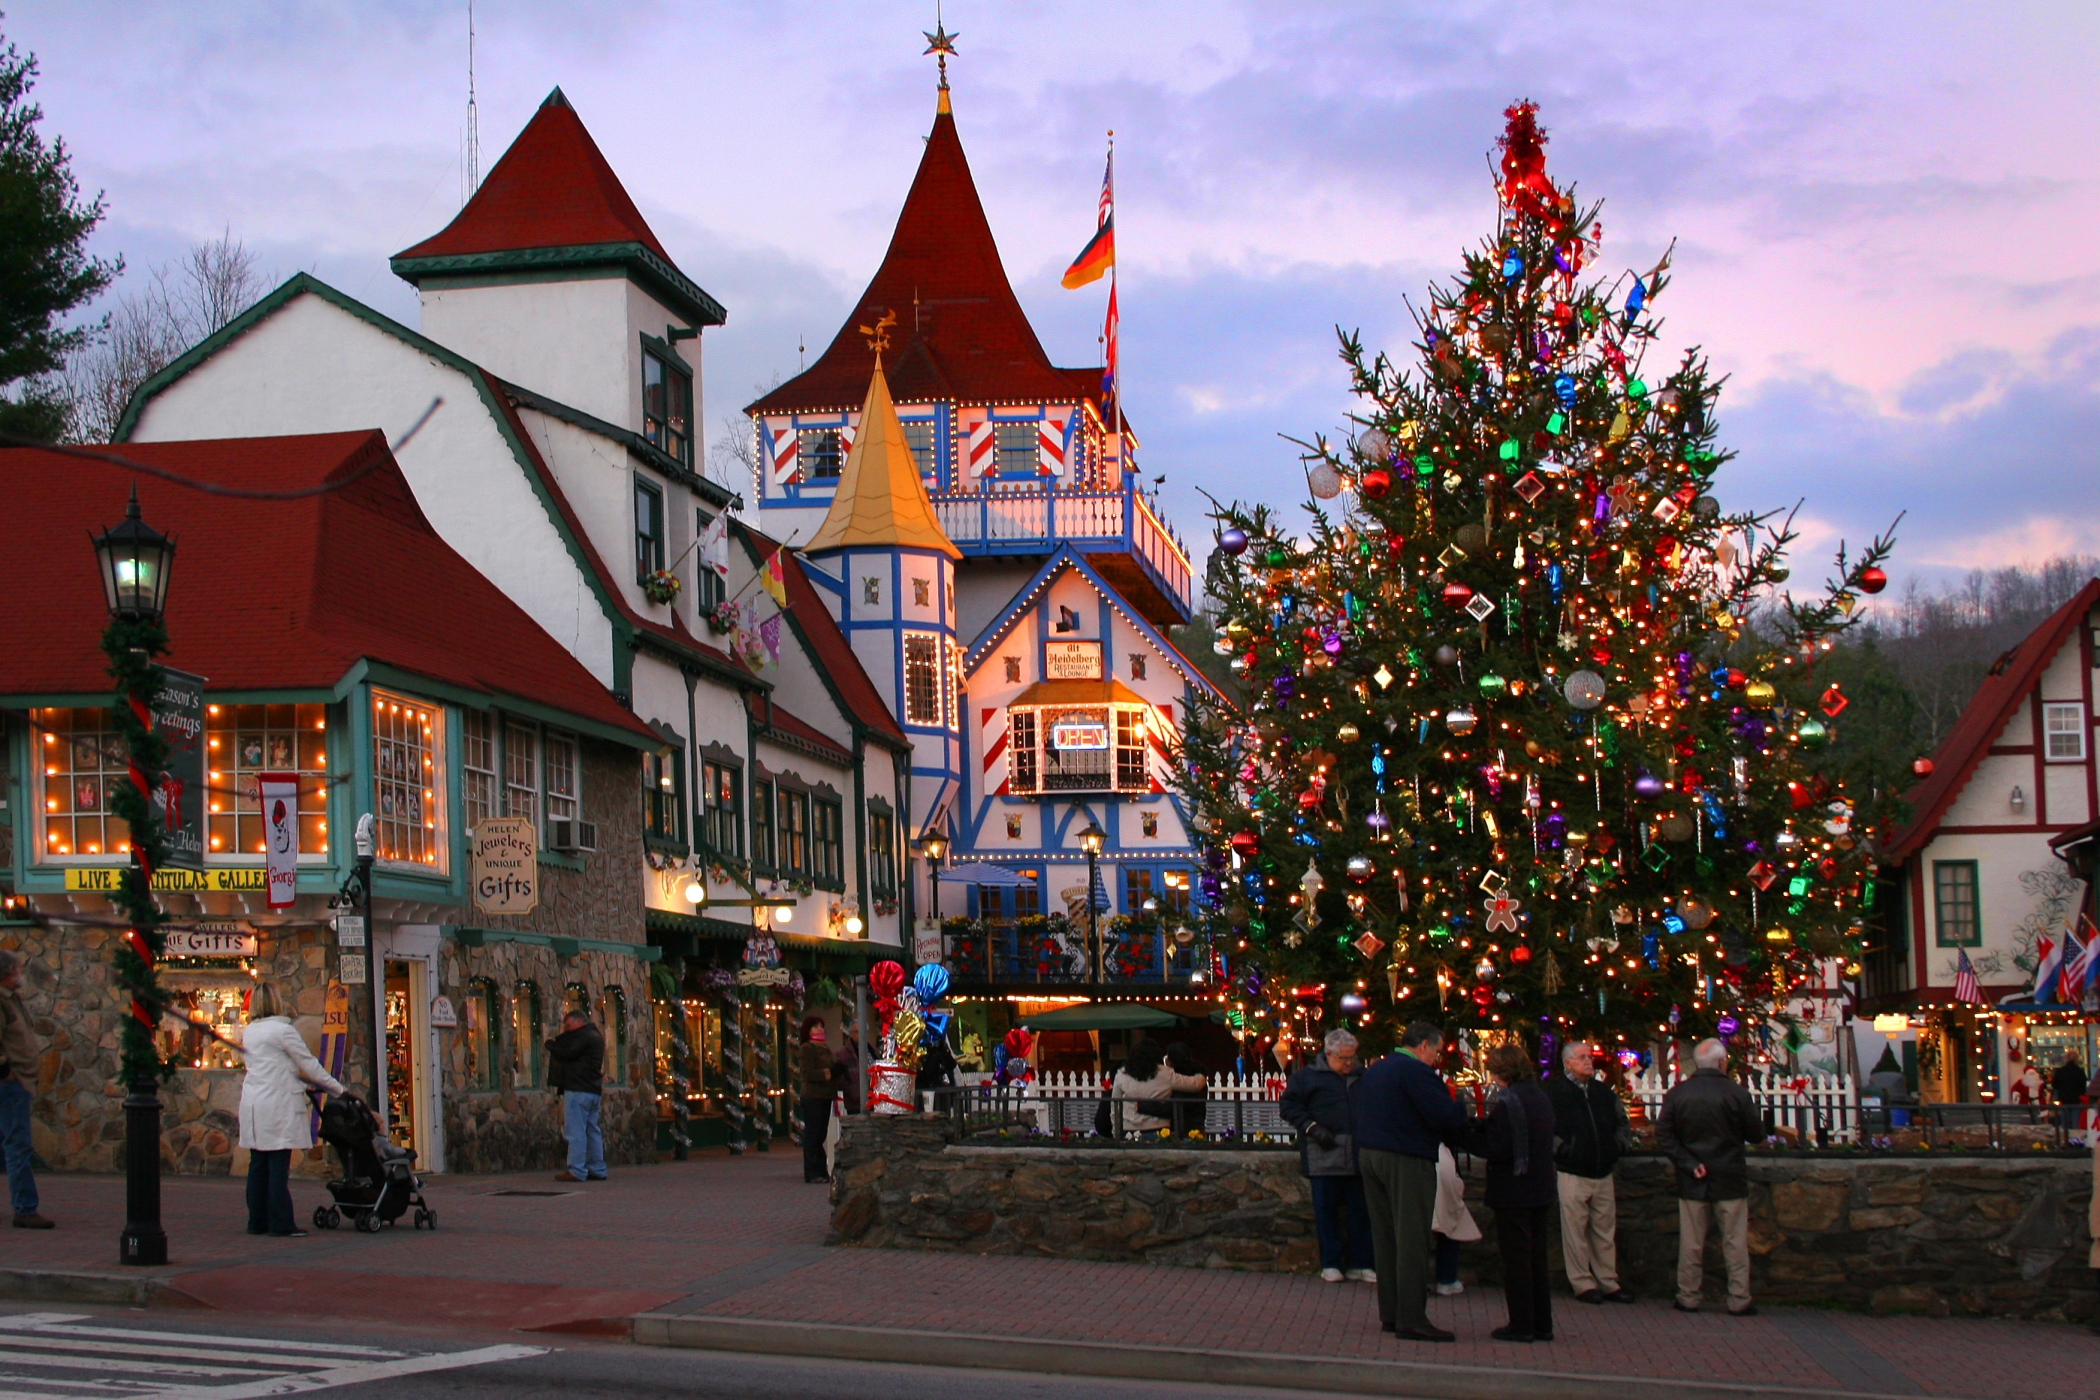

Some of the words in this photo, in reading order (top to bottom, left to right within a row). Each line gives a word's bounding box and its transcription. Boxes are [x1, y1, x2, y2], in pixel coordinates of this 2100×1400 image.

[1048, 653, 1101, 667] Heidelberg
[155, 687, 199, 709] eason's
[1057, 728, 1105, 747] OPEN
[487, 826, 520, 834] HELEN
[177, 830, 202, 853] Helen
[476, 834, 532, 857] Jewelers
[485, 860, 523, 869] UNIQUE
[78, 871, 112, 889] LIVE
[478, 872, 532, 905] Gifts
[923, 950, 941, 960] OPEN
[324, 1011, 348, 1025] LSU
